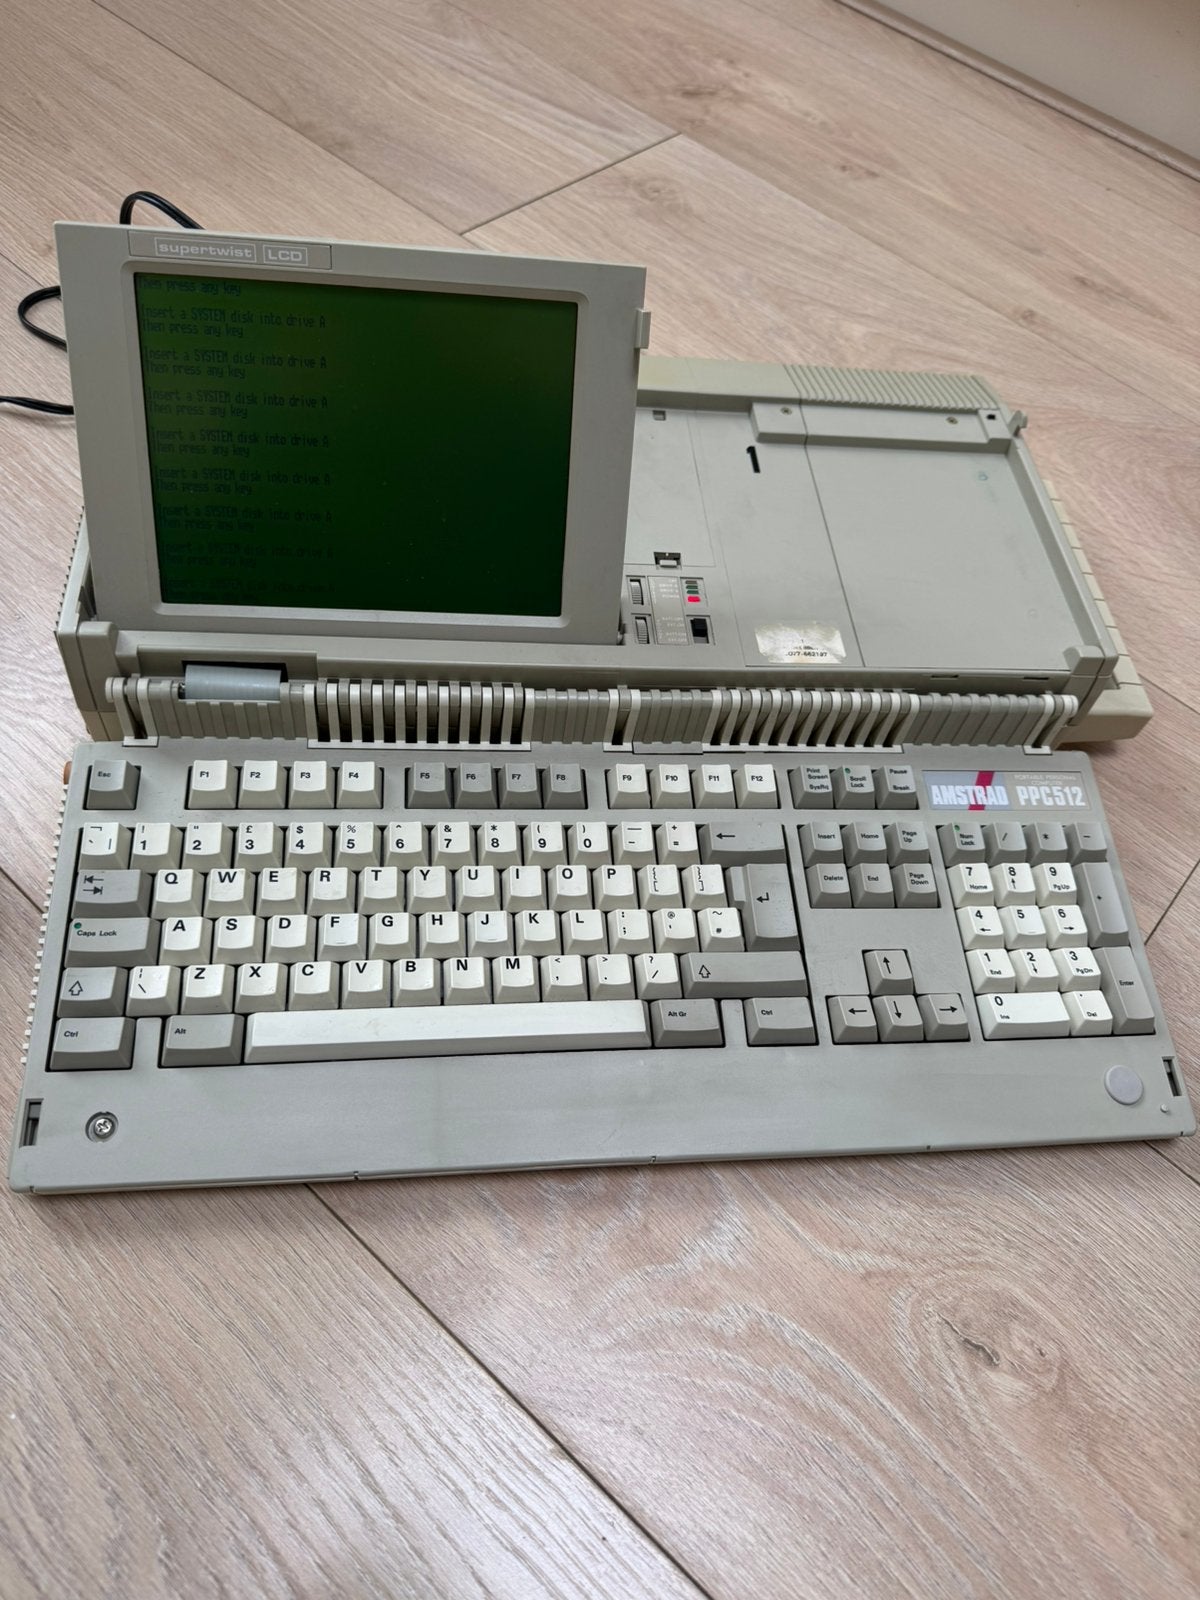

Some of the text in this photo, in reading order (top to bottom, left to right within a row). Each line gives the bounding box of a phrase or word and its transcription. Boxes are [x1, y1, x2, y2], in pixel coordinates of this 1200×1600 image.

[158, 242, 303, 262] supertwist LCD
[142, 304, 173, 319] Insert
[191, 307, 226, 322] SYSTEM
[231, 310, 252, 324] disk
[260, 313, 281, 326] into
[286, 312, 316, 327] drive
[142, 319, 243, 338] Then press any key
[746, 446, 761, 473] 1
[931, 785, 1009, 805] AMSTRAD
[1015, 786, 1086, 806] PPC512
[297, 826, 303, 834] $
[141, 840, 146, 850] 1
[193, 840, 201, 850] 2
[245, 840, 254, 849] 3
[296, 840, 304, 849] 4
[347, 839, 355, 849] 5
[396, 839, 404, 848] 6
[444, 839, 451, 848] 7
[491, 838, 499, 847] 8
[538, 838, 546, 848] 9
[584, 839, 591, 848] 0
[320, 871, 330, 881] R
[371, 870, 381, 881] T
[420, 870, 430, 880] Y
[468, 869, 478, 880] U
[516, 869, 519, 879] I
[562, 868, 573, 879] O
[607, 868, 616, 879] P
[966, 867, 972, 875] 7
[1009, 867, 1016, 876] 8
[1049, 867, 1056, 876] 9
[165, 873, 178, 884] Q
[218, 872, 237, 883] W
[270, 871, 278, 882] E
[529, 913, 539, 923] K
[576, 913, 584, 923] L
[976, 910, 982, 919] 4
[1017, 910, 1024, 918] 5
[1058, 909, 1066, 918] 6
[226, 919, 237, 930] S
[279, 918, 291, 929] D
[331, 917, 340, 927] F
[382, 916, 393, 927] G
[432, 915, 442, 925] H
[481, 914, 489, 925] J
[173, 920, 185, 931] A
[984, 953, 990, 961] 1
[1027, 952, 1035, 961] 2
[1070, 951, 1078, 960] 3
[356, 963, 367, 973] V
[406, 961, 416, 972] B
[457, 959, 467, 970] N
[506, 958, 520, 969] M
[194, 968, 205, 979] Z
[249, 966, 261, 977] X
[302, 964, 313, 976] C
[995, 996, 1003, 1006] 0
